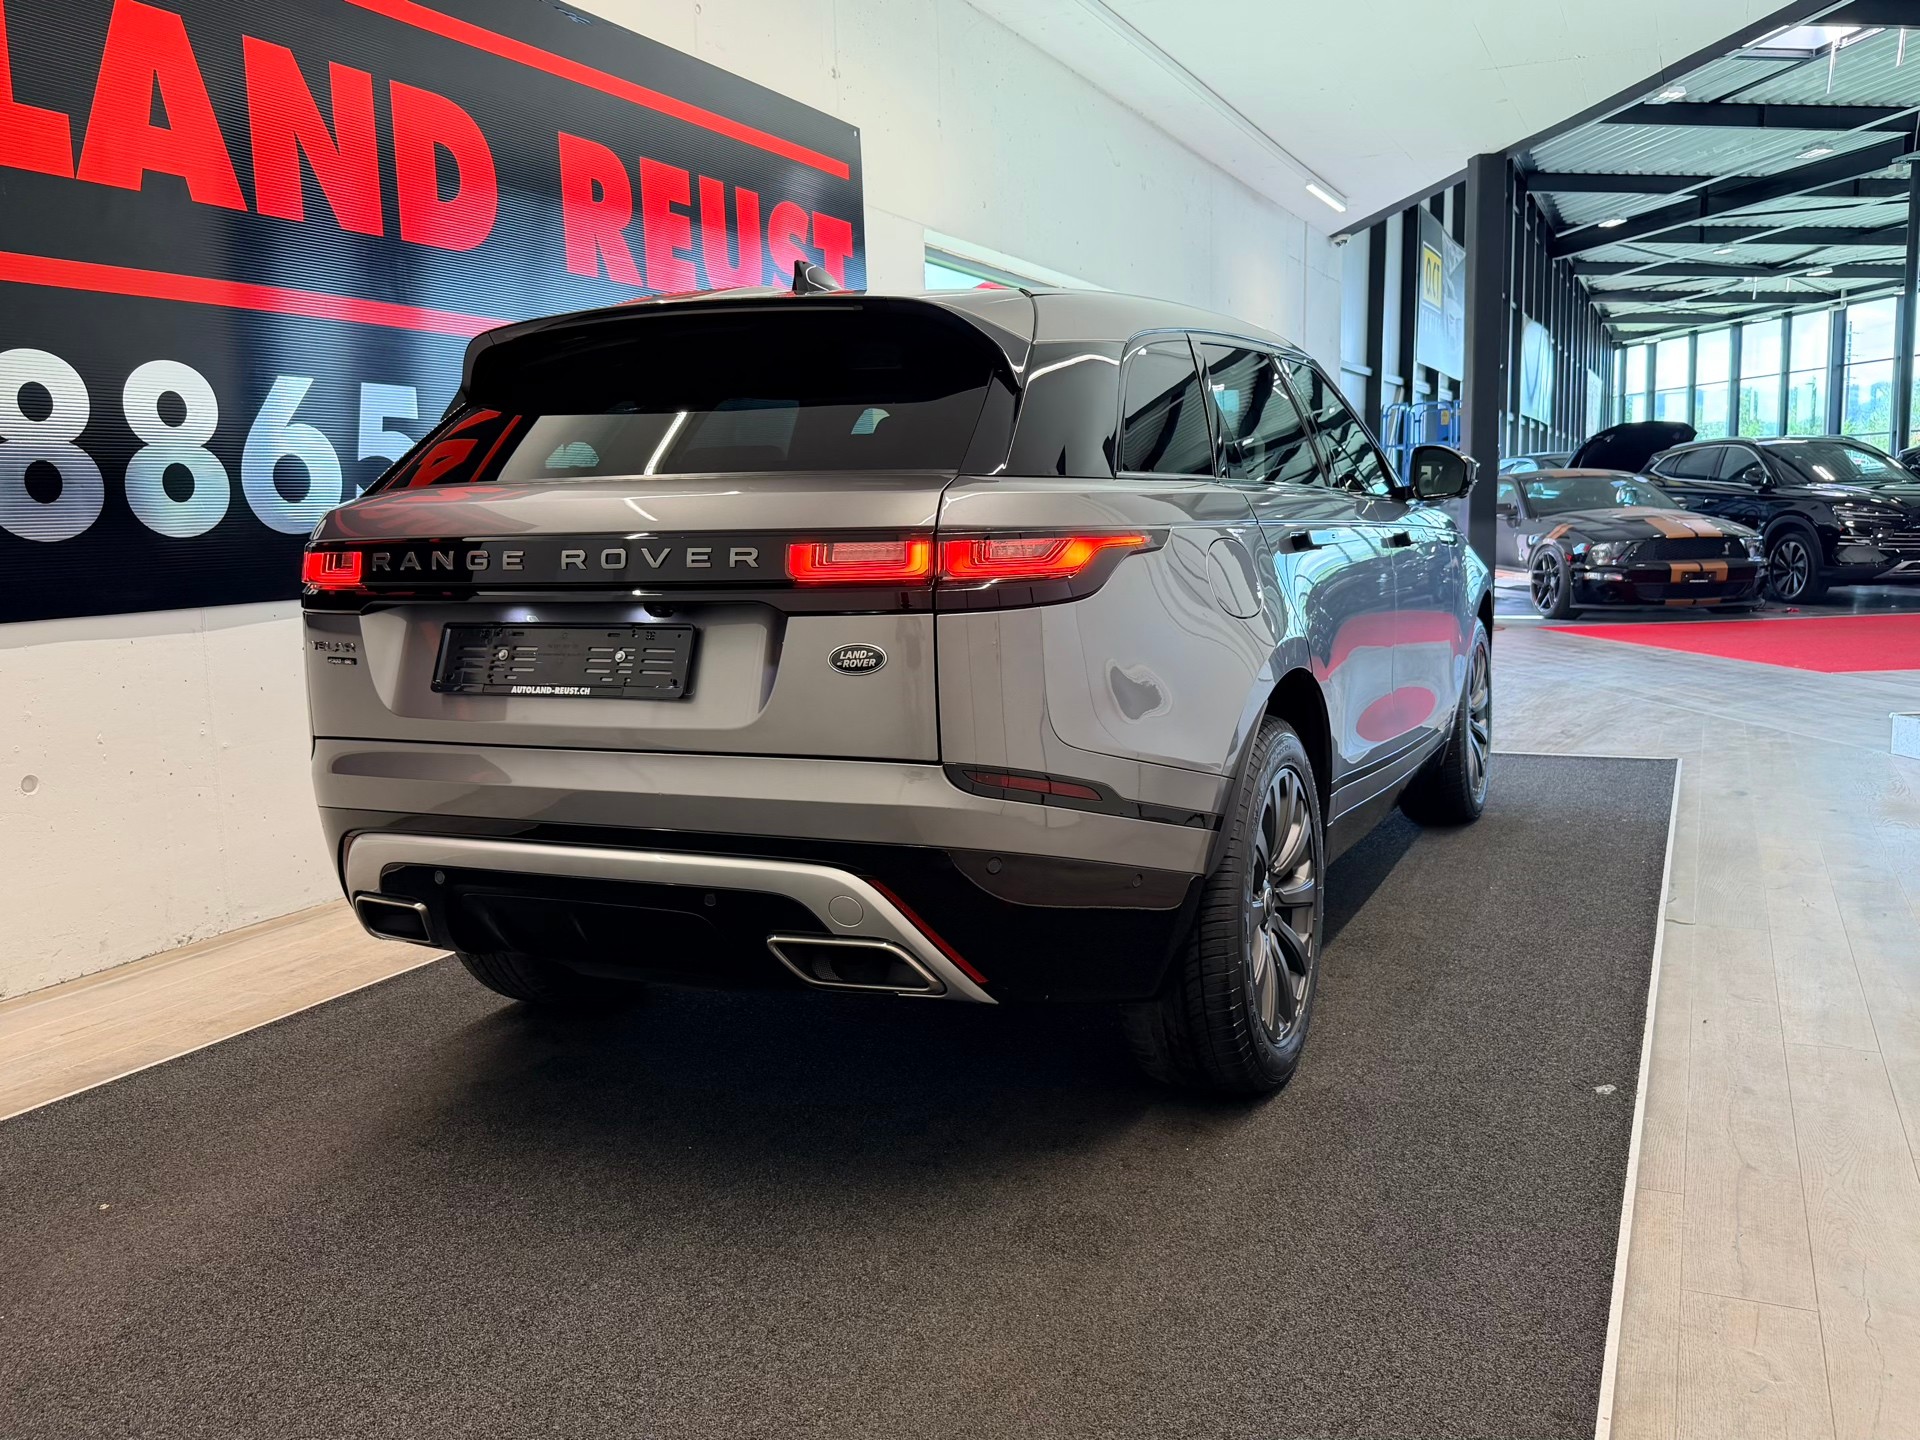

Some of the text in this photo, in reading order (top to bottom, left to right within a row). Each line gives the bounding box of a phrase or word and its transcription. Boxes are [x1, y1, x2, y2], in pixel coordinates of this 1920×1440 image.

[557, 130, 854, 293] REUST
[370, 547, 760, 572] RANGE ROVER
[840, 650, 867, 660] LAND
[842, 658, 876, 668] ROVER
[511, 685, 591, 696] AUTOLAND-REUST.CH
